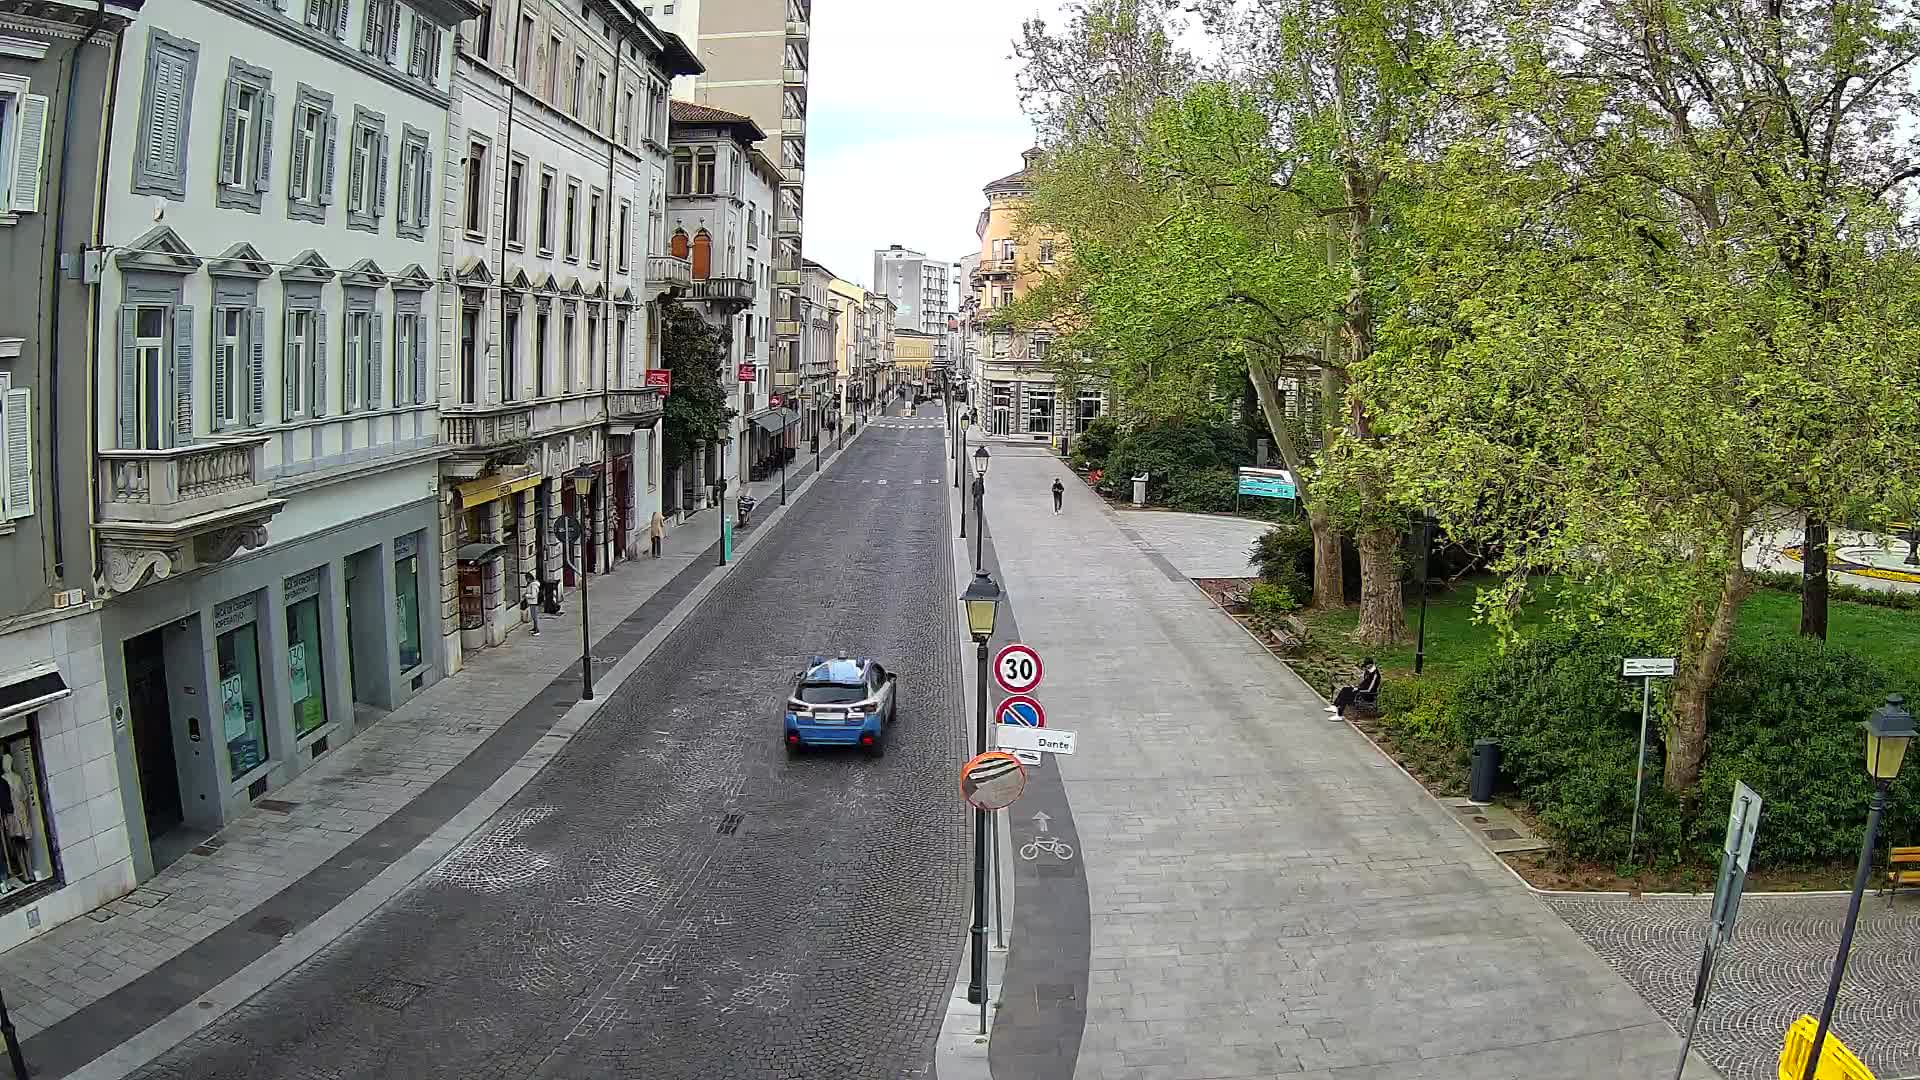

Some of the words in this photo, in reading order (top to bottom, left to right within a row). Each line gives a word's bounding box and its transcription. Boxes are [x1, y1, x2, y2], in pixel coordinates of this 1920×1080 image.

[1006, 658, 1033, 680] 30
[222, 678, 240, 700] 130
[1038, 738, 1069, 749] Dante
